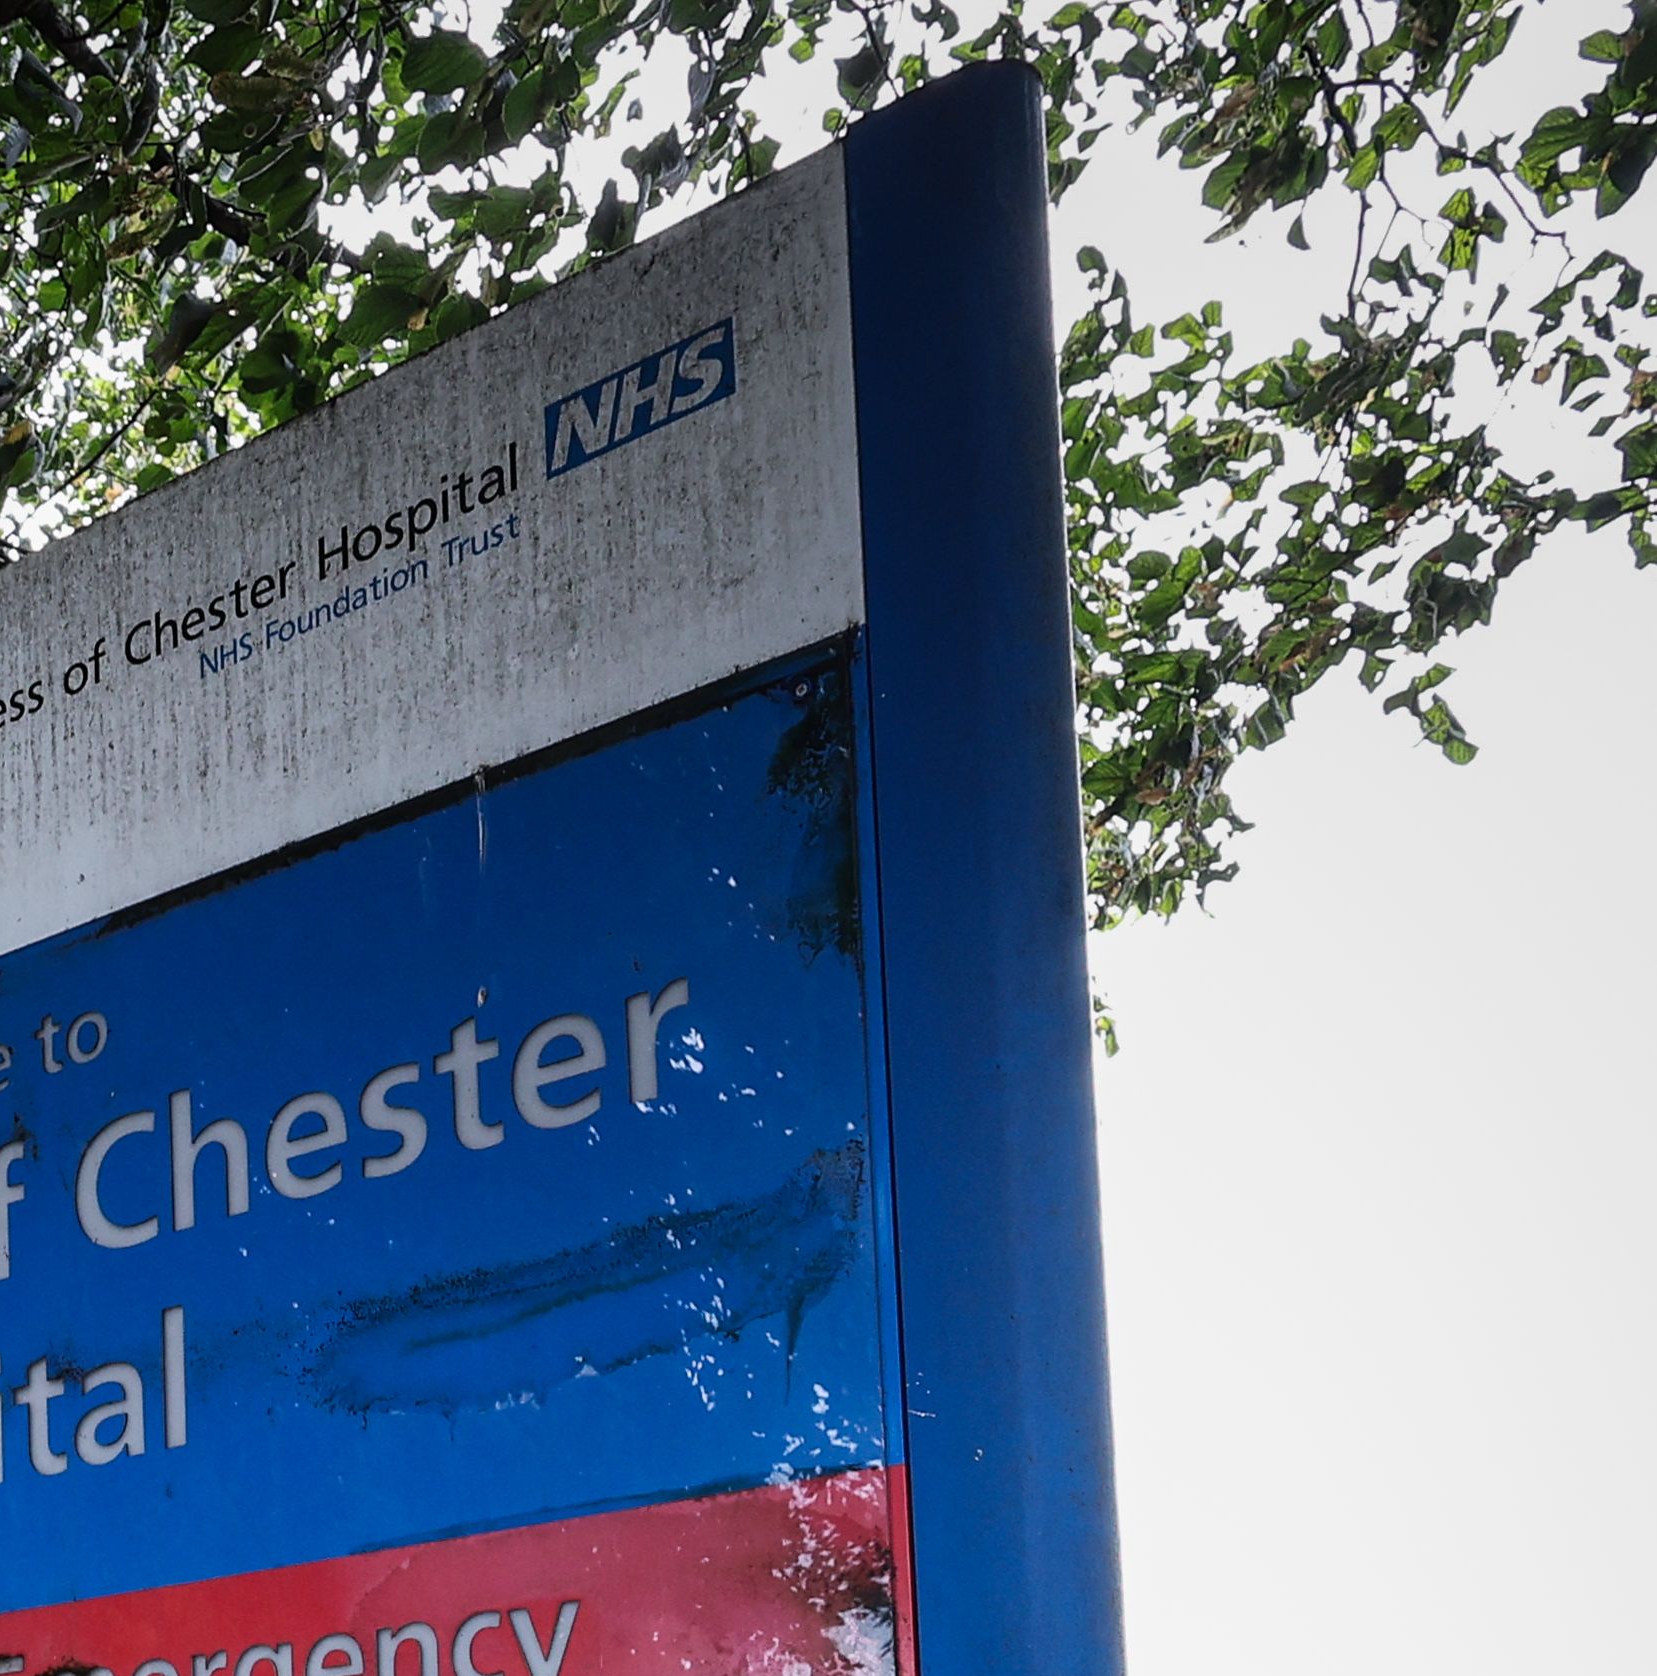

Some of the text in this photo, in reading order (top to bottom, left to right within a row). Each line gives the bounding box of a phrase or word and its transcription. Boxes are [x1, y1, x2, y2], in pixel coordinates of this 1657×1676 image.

[551, 327, 727, 470] NHS
[64, 637, 106, 696] of
[125, 562, 295, 665] Chester
[318, 442, 518, 581] Hospital
[199, 513, 520, 678] NHS Foundation Trust
[35, 1011, 108, 1074] to
[75, 977, 689, 1249] Chester
